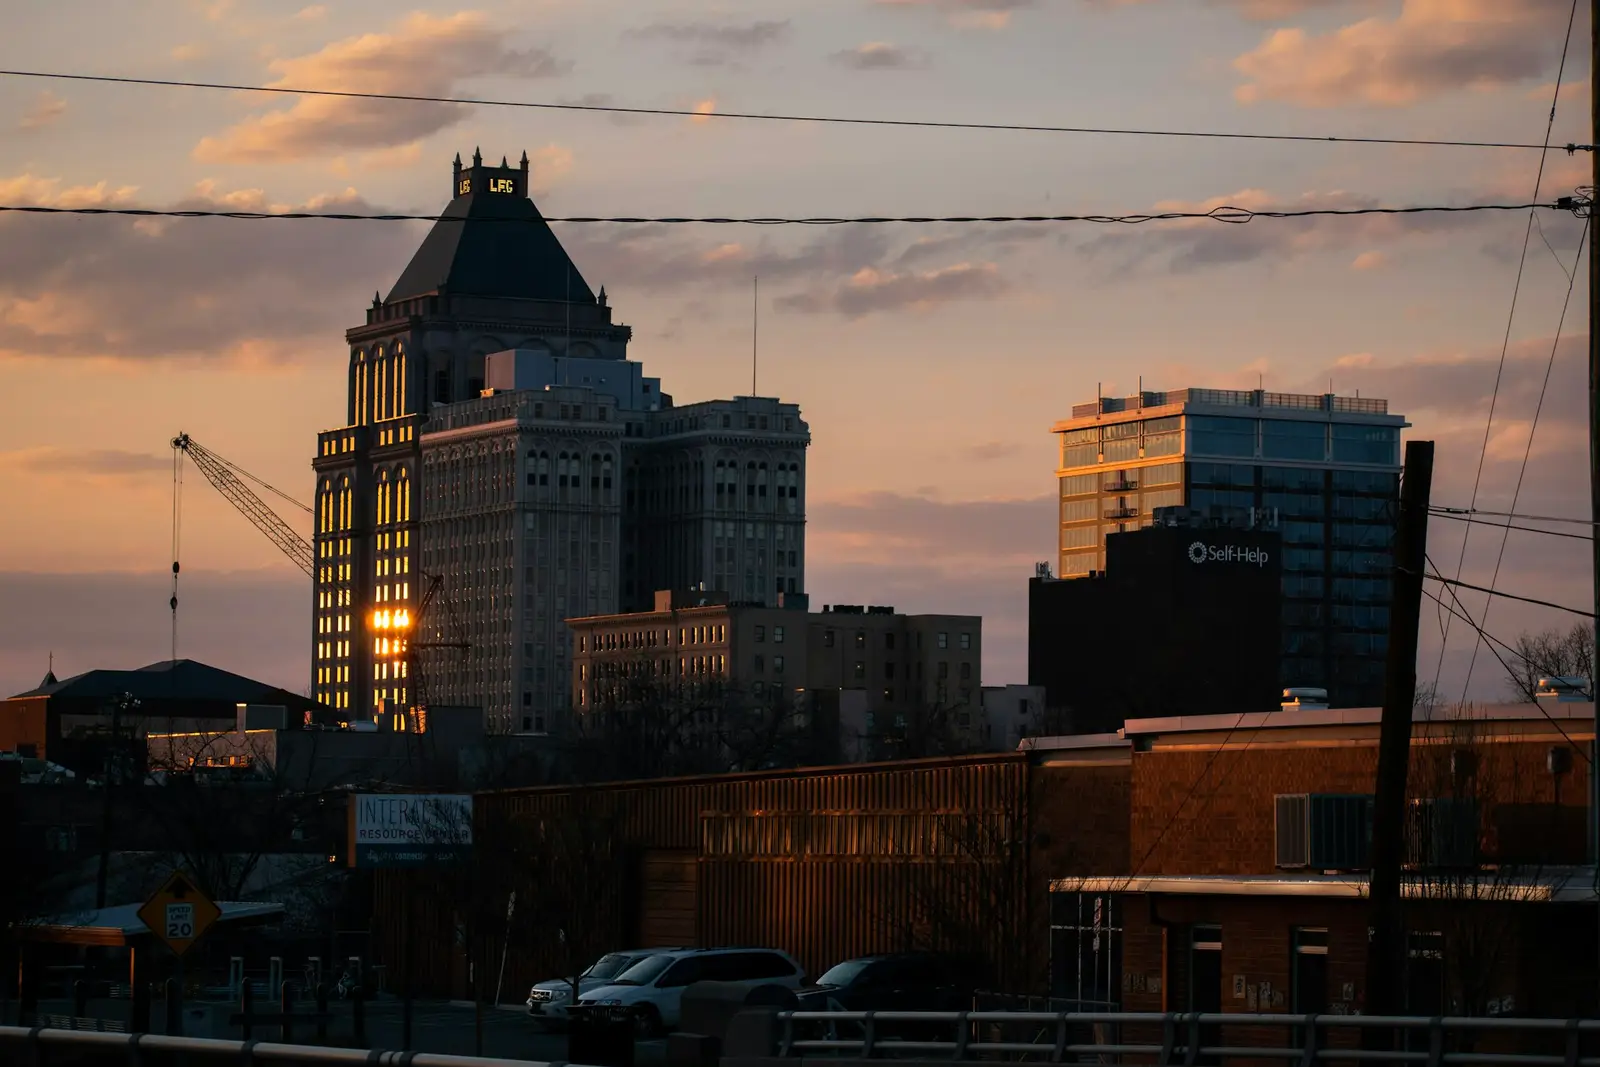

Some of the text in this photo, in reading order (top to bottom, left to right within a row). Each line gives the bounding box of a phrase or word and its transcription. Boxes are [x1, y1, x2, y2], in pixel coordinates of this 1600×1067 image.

[489, 178, 514, 194] LFG
[1208, 544, 1269, 568] Self-Help
[359, 829, 421, 839] RESOURCE
[168, 923, 192, 937] 20
